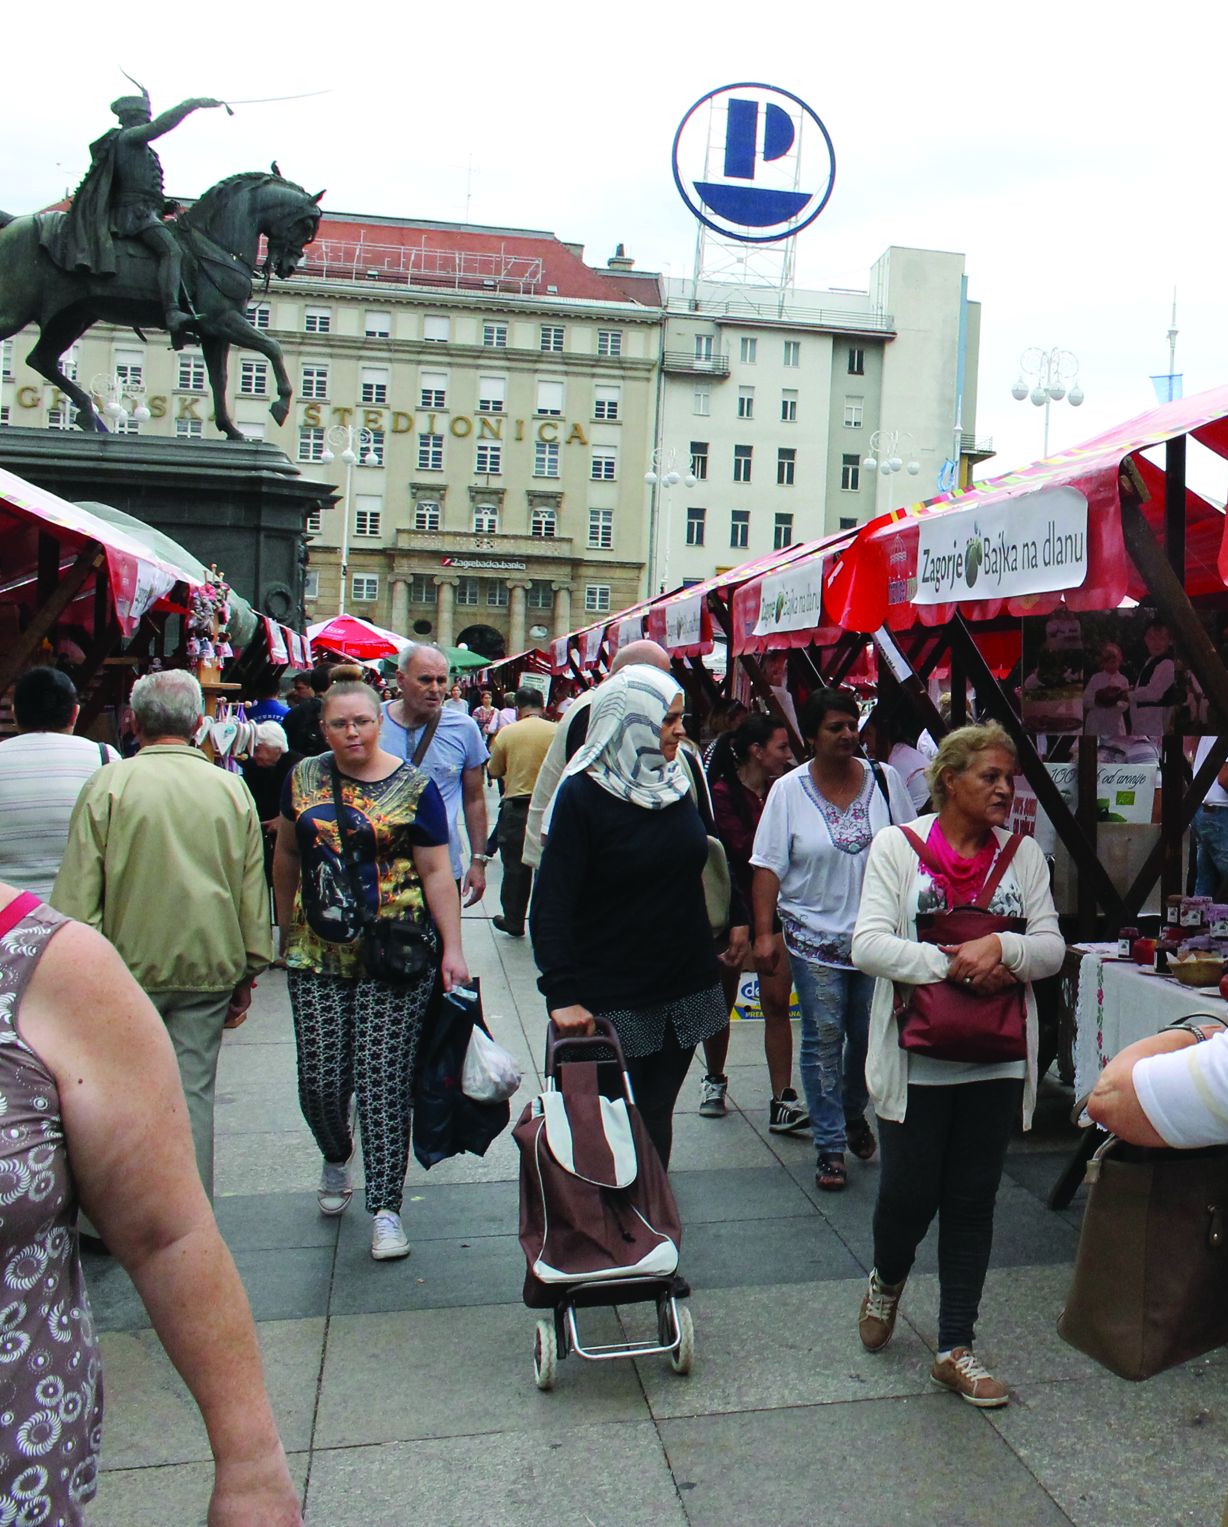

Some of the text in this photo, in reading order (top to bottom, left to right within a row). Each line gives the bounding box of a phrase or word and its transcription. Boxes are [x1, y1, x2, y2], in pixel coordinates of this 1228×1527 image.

[303, 402, 588, 445] ŠTEDIONICA
[921, 540, 963, 593] Zagorje
[983, 527, 1018, 586] Bajka
[1022, 541, 1038, 571] na
[1042, 521, 1083, 566] dlanu
